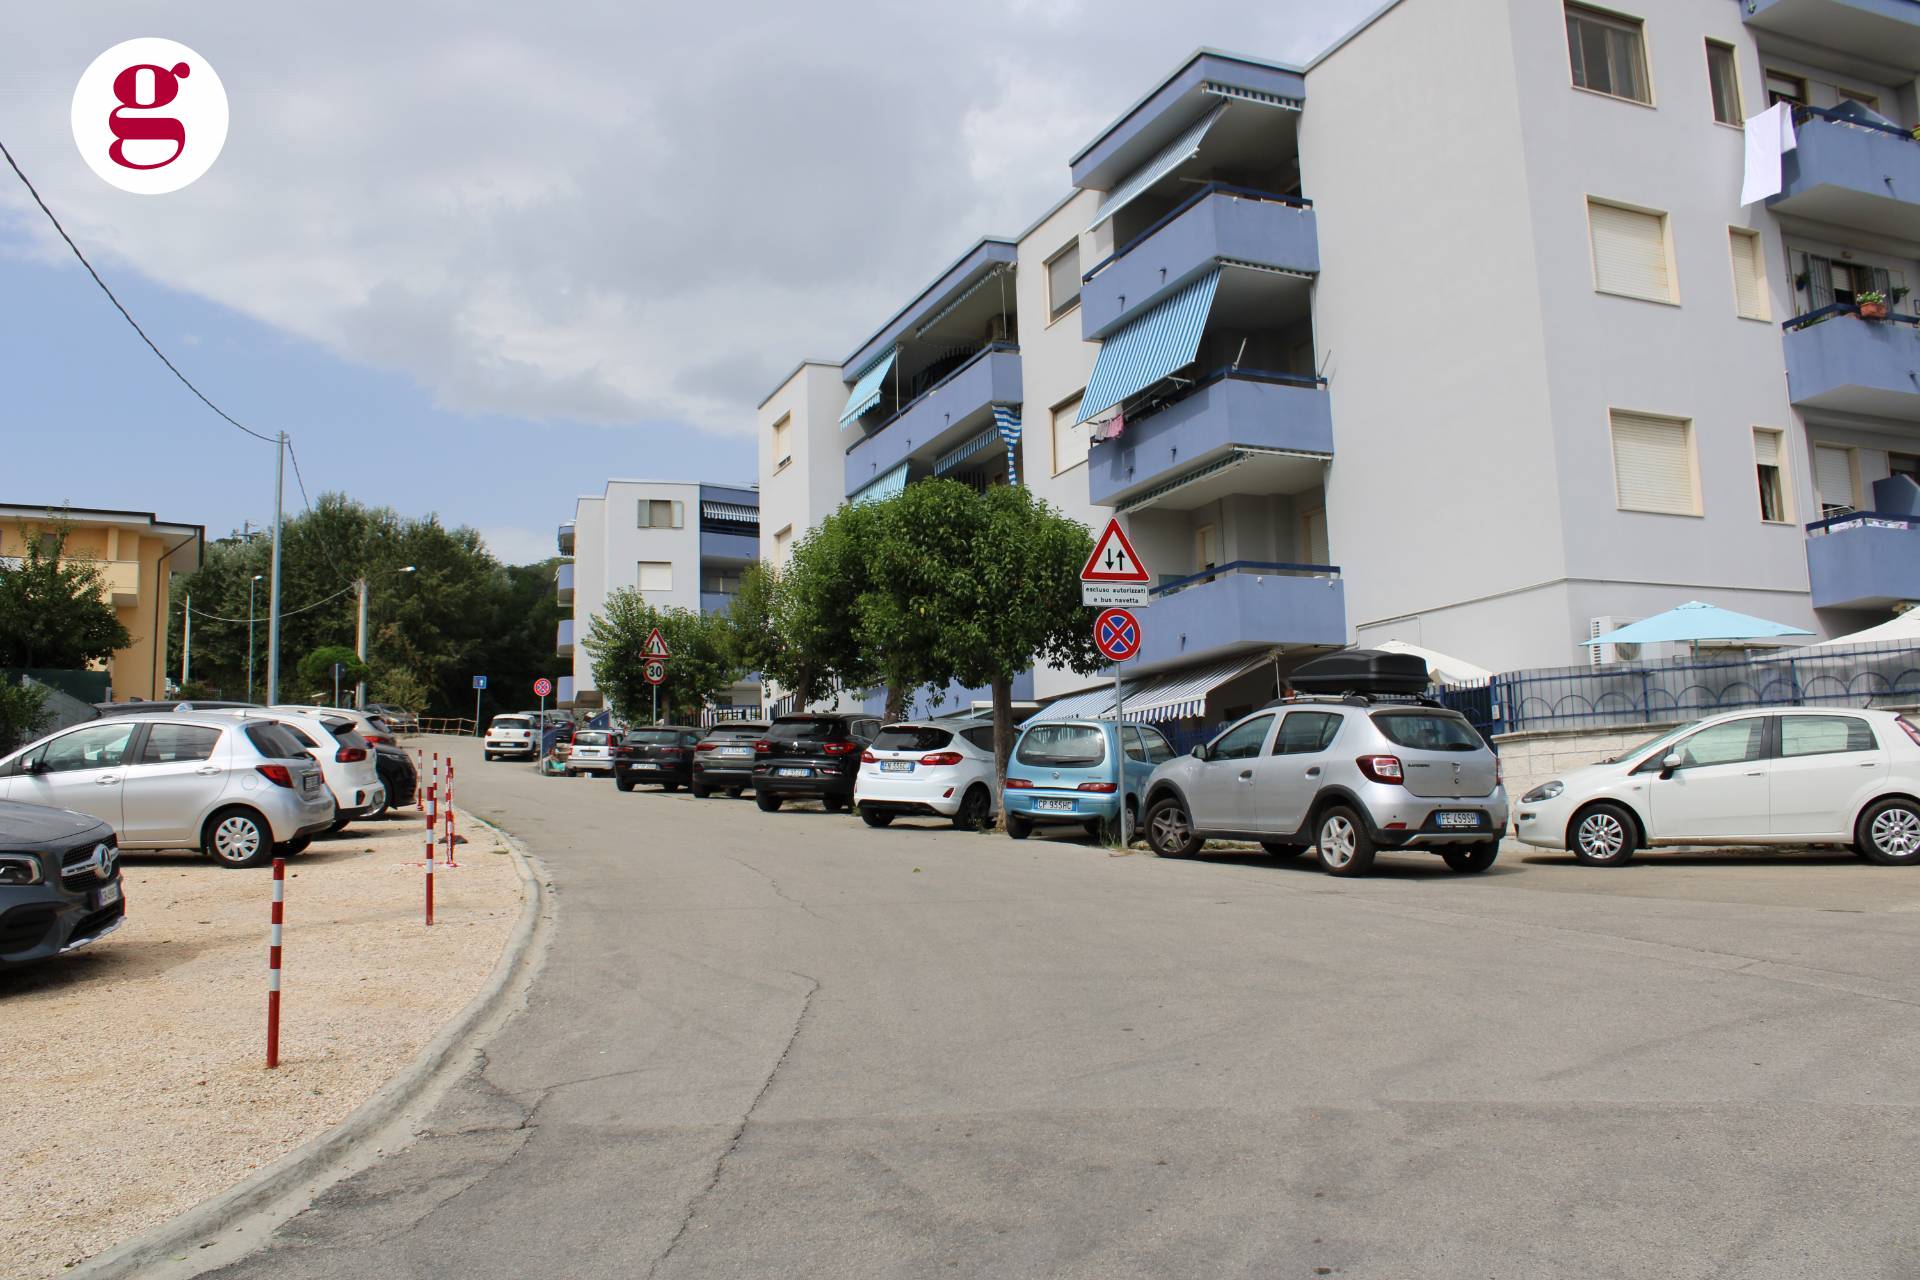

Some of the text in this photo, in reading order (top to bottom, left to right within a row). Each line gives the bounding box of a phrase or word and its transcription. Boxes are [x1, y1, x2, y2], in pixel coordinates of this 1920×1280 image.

[649, 665, 662, 678] 30
[1038, 800, 1048, 809] CP
[1441, 812, 1476, 824] FE 459SH
